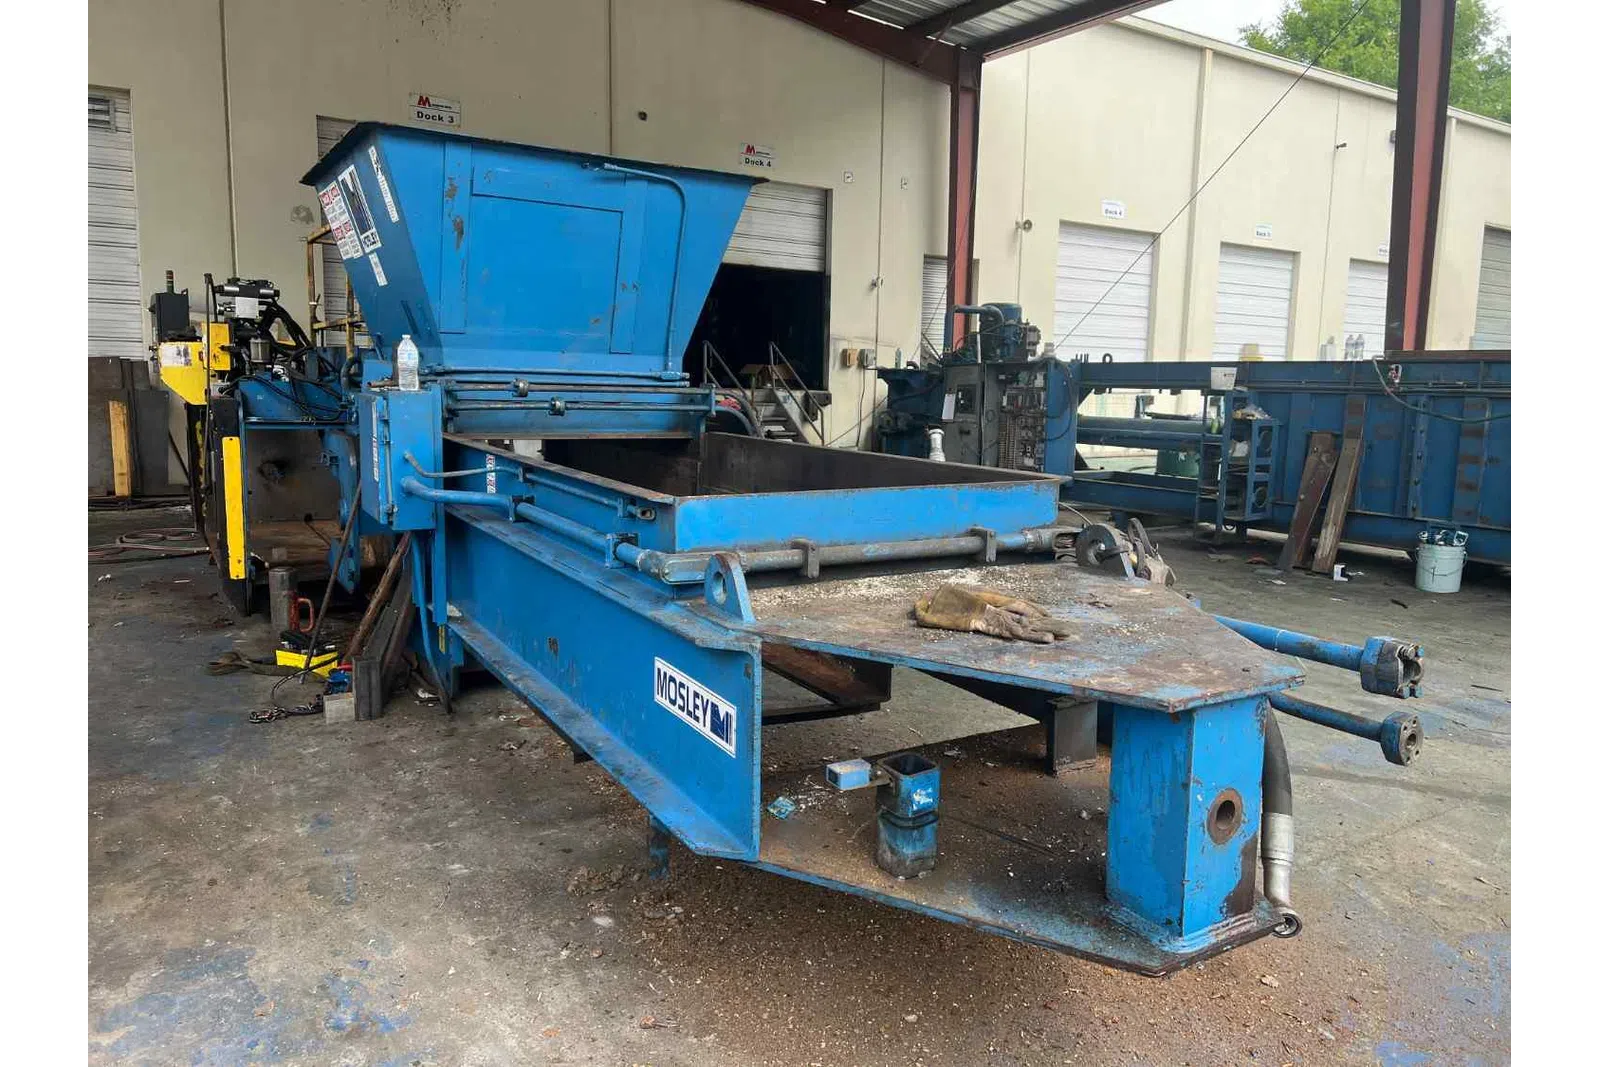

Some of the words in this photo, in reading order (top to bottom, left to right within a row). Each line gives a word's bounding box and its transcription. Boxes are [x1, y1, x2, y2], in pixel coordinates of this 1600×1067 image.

[416, 111, 444, 122] Dock
[448, 115, 454, 123] 3
[745, 157, 764, 167] Dock
[657, 667, 709, 728] MOSLEY
